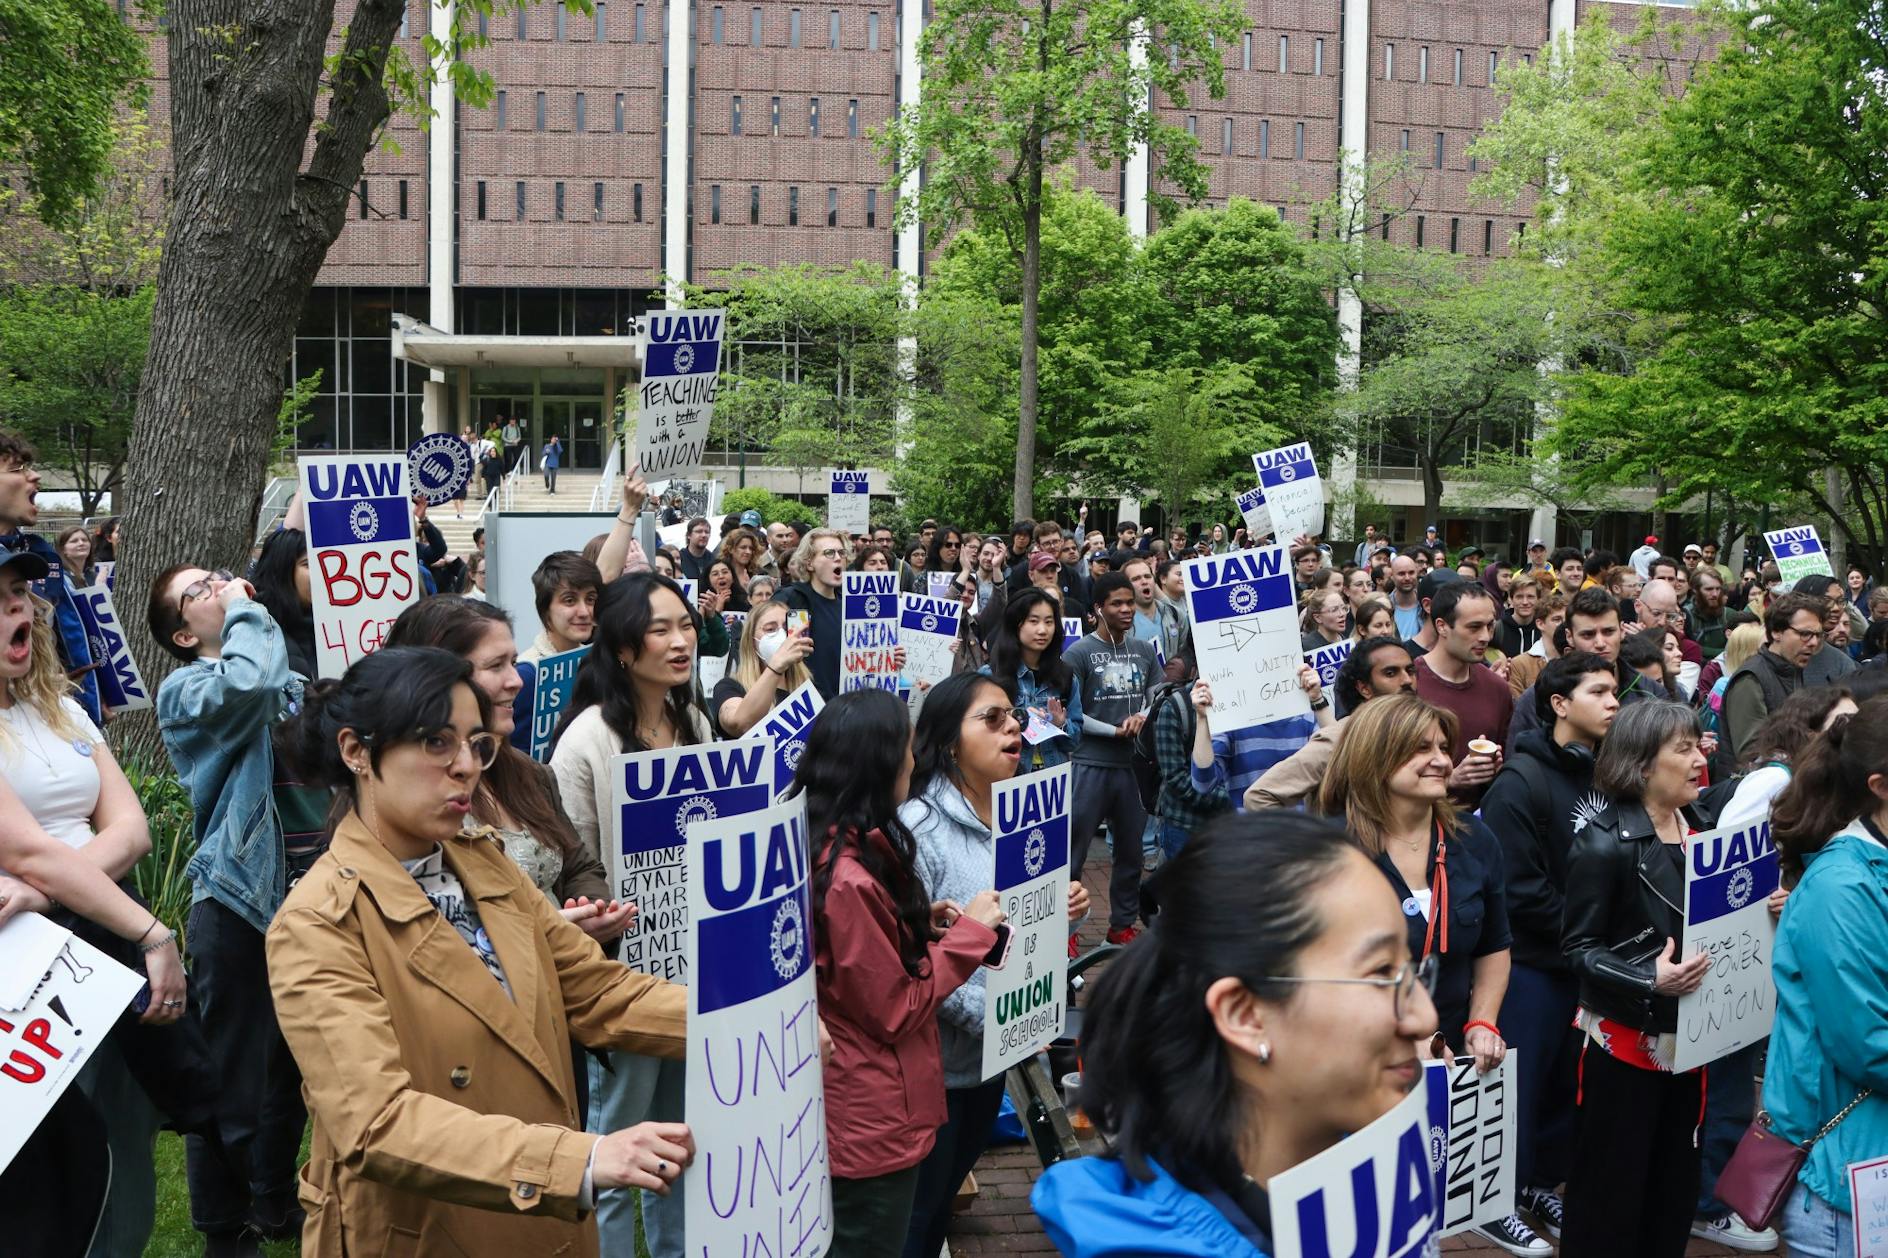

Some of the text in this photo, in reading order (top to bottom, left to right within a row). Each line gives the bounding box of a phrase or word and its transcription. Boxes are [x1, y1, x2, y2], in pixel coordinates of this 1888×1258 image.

[650, 315, 720, 343] UAW
[641, 376, 717, 409] TEACHING
[656, 409, 701, 428] is better
[650, 428, 686, 445] with a
[422, 457, 451, 483] UAW
[640, 439, 703, 473] UNION
[1257, 446, 1306, 470] UAW
[307, 462, 402, 500] UAW
[833, 473, 867, 482] UAW
[1238, 489, 1262, 504] UAW
[1768, 528, 1812, 544] UAW
[317, 550, 413, 606] BGS
[1190, 549, 1283, 589] UAW
[847, 576, 896, 595] UAW
[906, 596, 959, 617] UAW
[90, 592, 145, 699] UAW
[322, 620, 350, 666] 4
[845, 620, 899, 648] UNION
[845, 650, 898, 673] UNION
[908, 647, 920, 658] IS
[1255, 652, 1298, 674] UNITY
[539, 657, 582, 686] PHI
[930, 666, 944, 677] IS
[541, 688, 561, 711] IS
[1232, 689, 1247, 708] all
[752, 689, 816, 751] AW
[625, 745, 766, 801] UAW
[998, 773, 1067, 835] UAW
[624, 846, 685, 869] UNION?
[1693, 820, 1776, 878] UAW
[642, 865, 688, 892] YALE
[642, 887, 687, 912] HAR
[1008, 881, 1057, 927] PENN
[644, 906, 688, 935] NORT
[650, 929, 688, 957] MI
[781, 928, 796, 951] UAW
[1025, 933, 1037, 956] IS
[1692, 937, 1736, 955] There
[651, 954, 688, 980] PEN
[1025, 962, 1033, 980] A
[996, 971, 1054, 1026] UNION
[1724, 984, 1733, 995] a
[1687, 979, 1766, 1043] UNION
[0, 995, 83, 1084] UP!
[1000, 1003, 1060, 1057] SCHOOL!
[705, 1000, 820, 1106] UNIO
[1432, 1138, 1440, 1162] UAW
[1447, 1057, 1481, 1230] UNION
[1480, 1067, 1505, 1205] NOW
[707, 1097, 826, 1219] UNIO
[1297, 1121, 1437, 1258] UA
